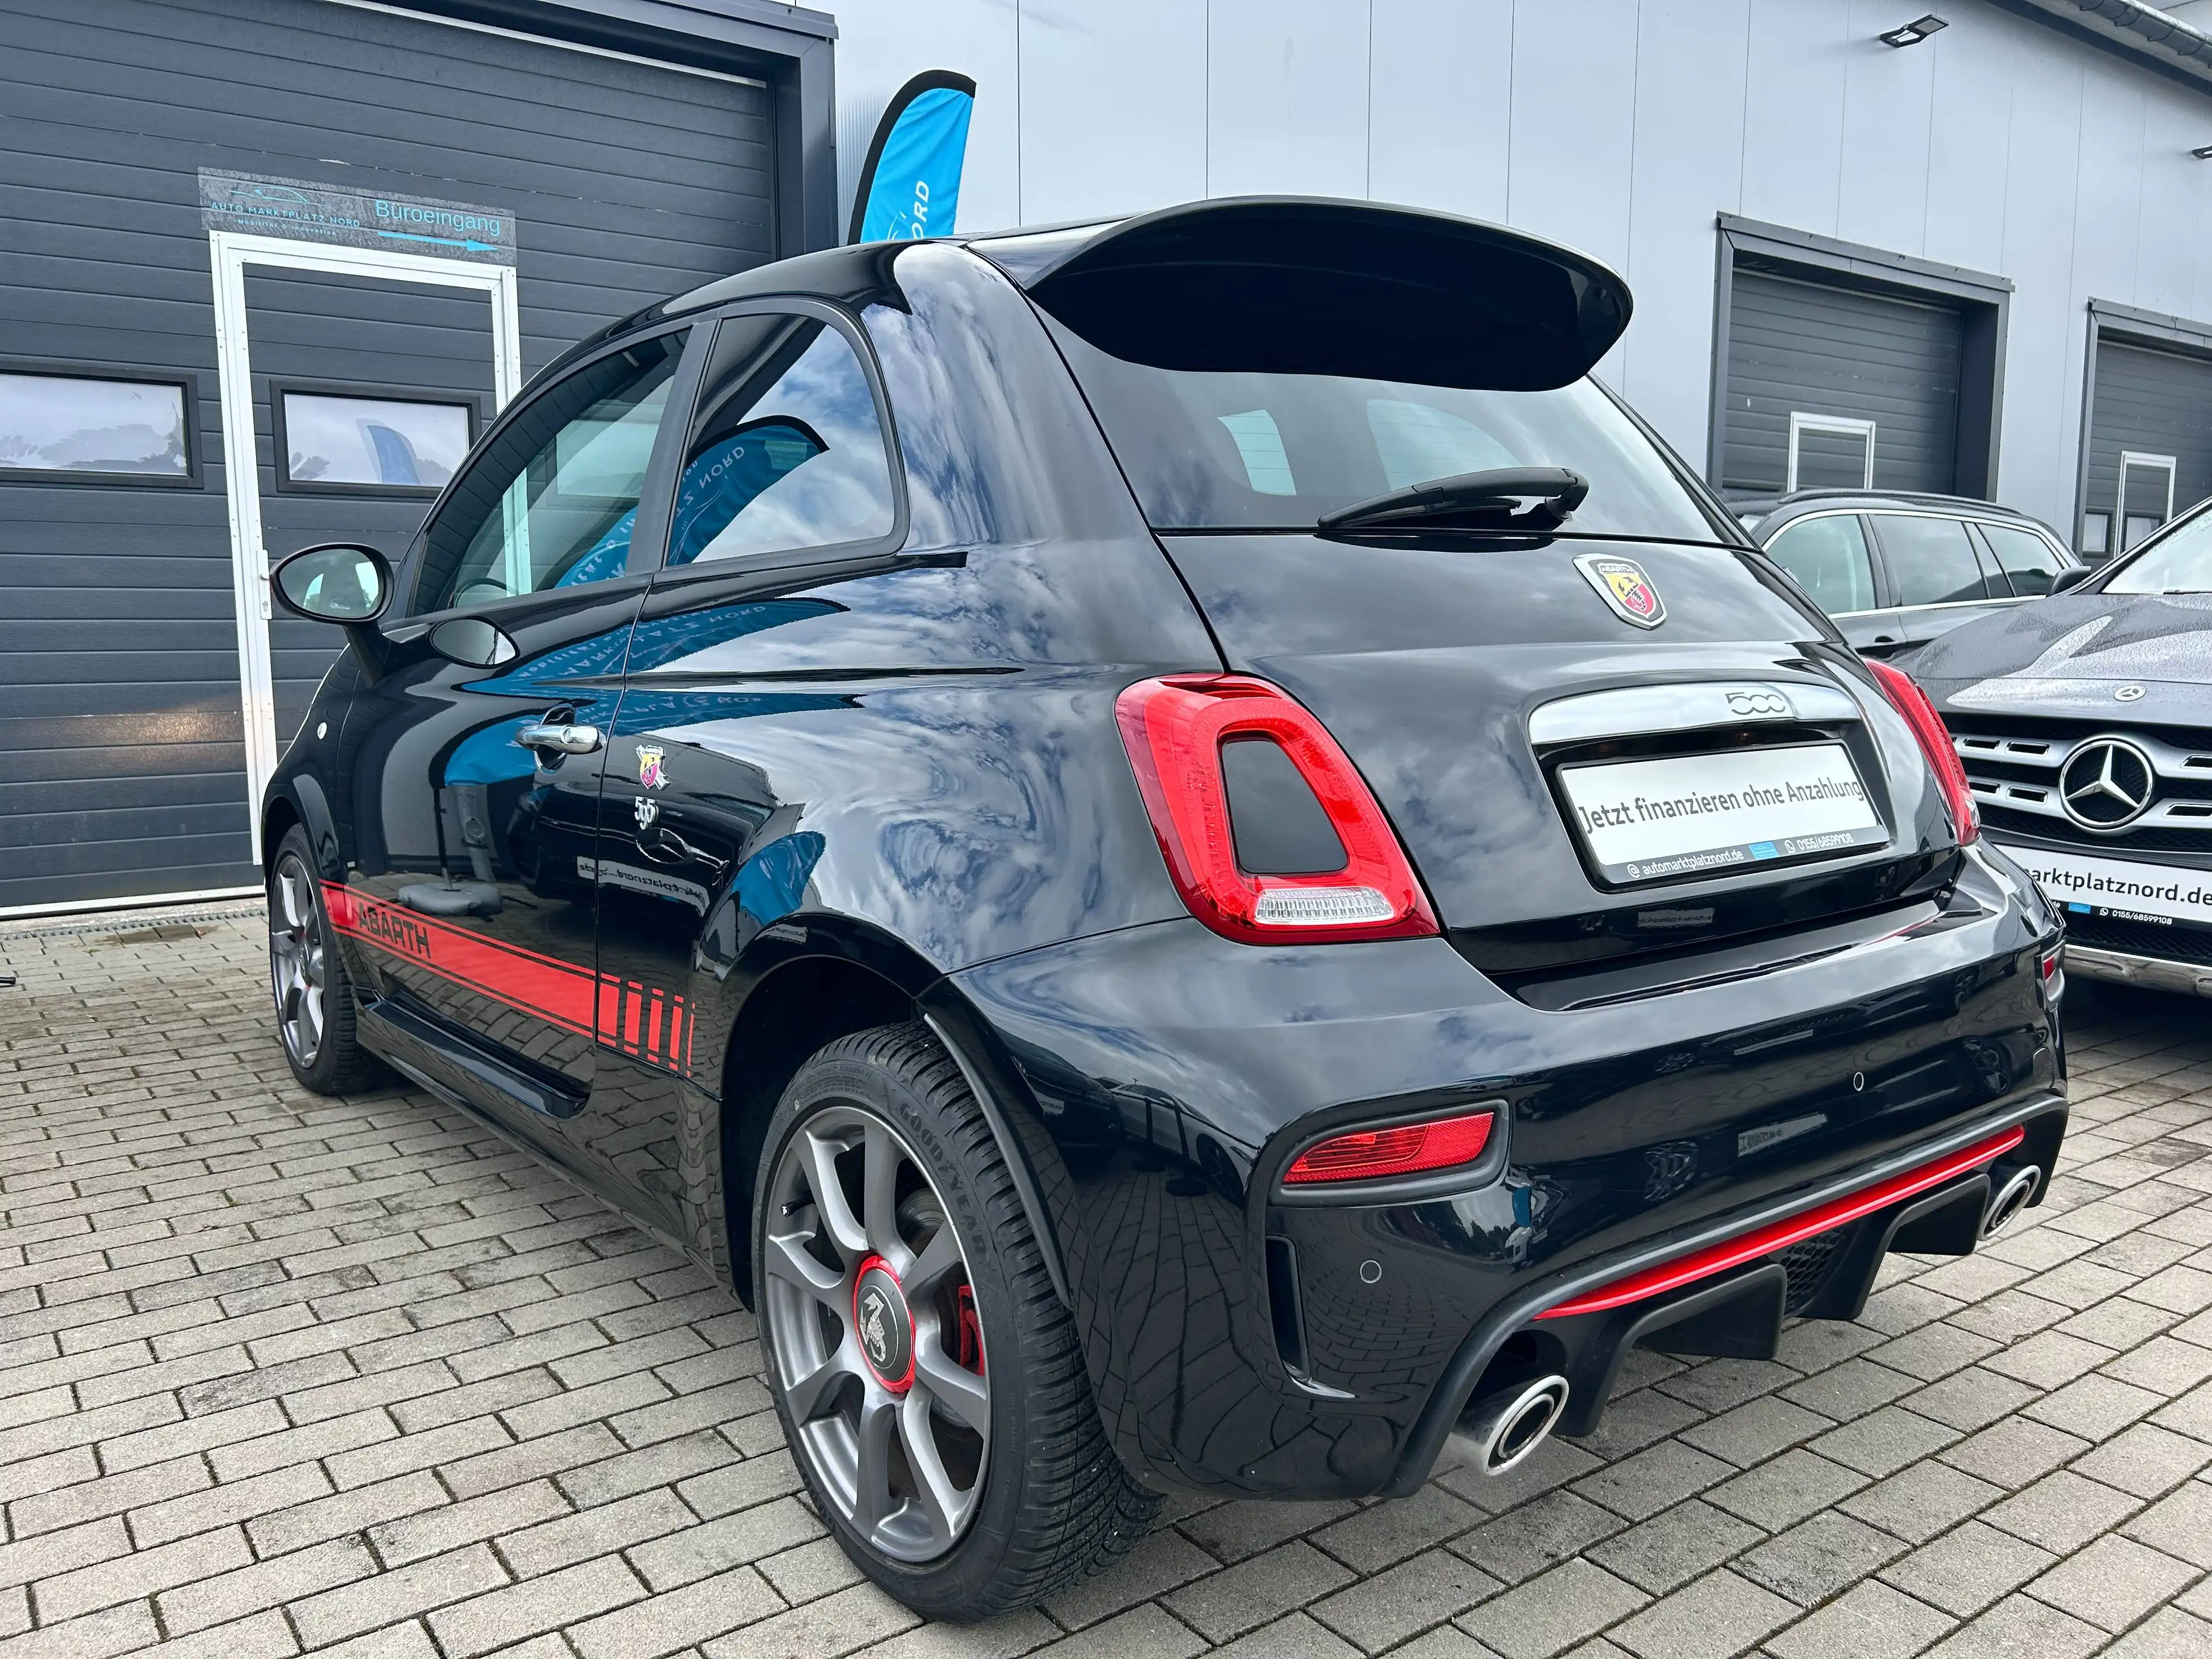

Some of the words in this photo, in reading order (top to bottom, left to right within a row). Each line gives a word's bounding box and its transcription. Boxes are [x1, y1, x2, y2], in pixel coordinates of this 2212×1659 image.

[211, 202, 244, 213] AUTO
[248, 207, 324, 223] MARKTPLATZ
[329, 217, 360, 228] NORD
[375, 199, 501, 236] Büroeingang
[912, 180, 929, 239] ORD
[1725, 692, 1785, 715] 500
[1578, 802, 1635, 834] Jetzt
[1635, 791, 1741, 821] finanzieren
[1744, 784, 1785, 807] ohne
[1786, 777, 1865, 802] Anzahlung
[1642, 849, 1744, 876] automarktplatznord.de
[1797, 832, 1854, 852] 0155/68599108
[2024, 868, 2212, 906] arktplatznord.de
[359, 903, 431, 959] ABARTH
[2112, 910, 2172, 925] 0155/68599108
[899, 1103, 987, 1255] GOODYEAR
